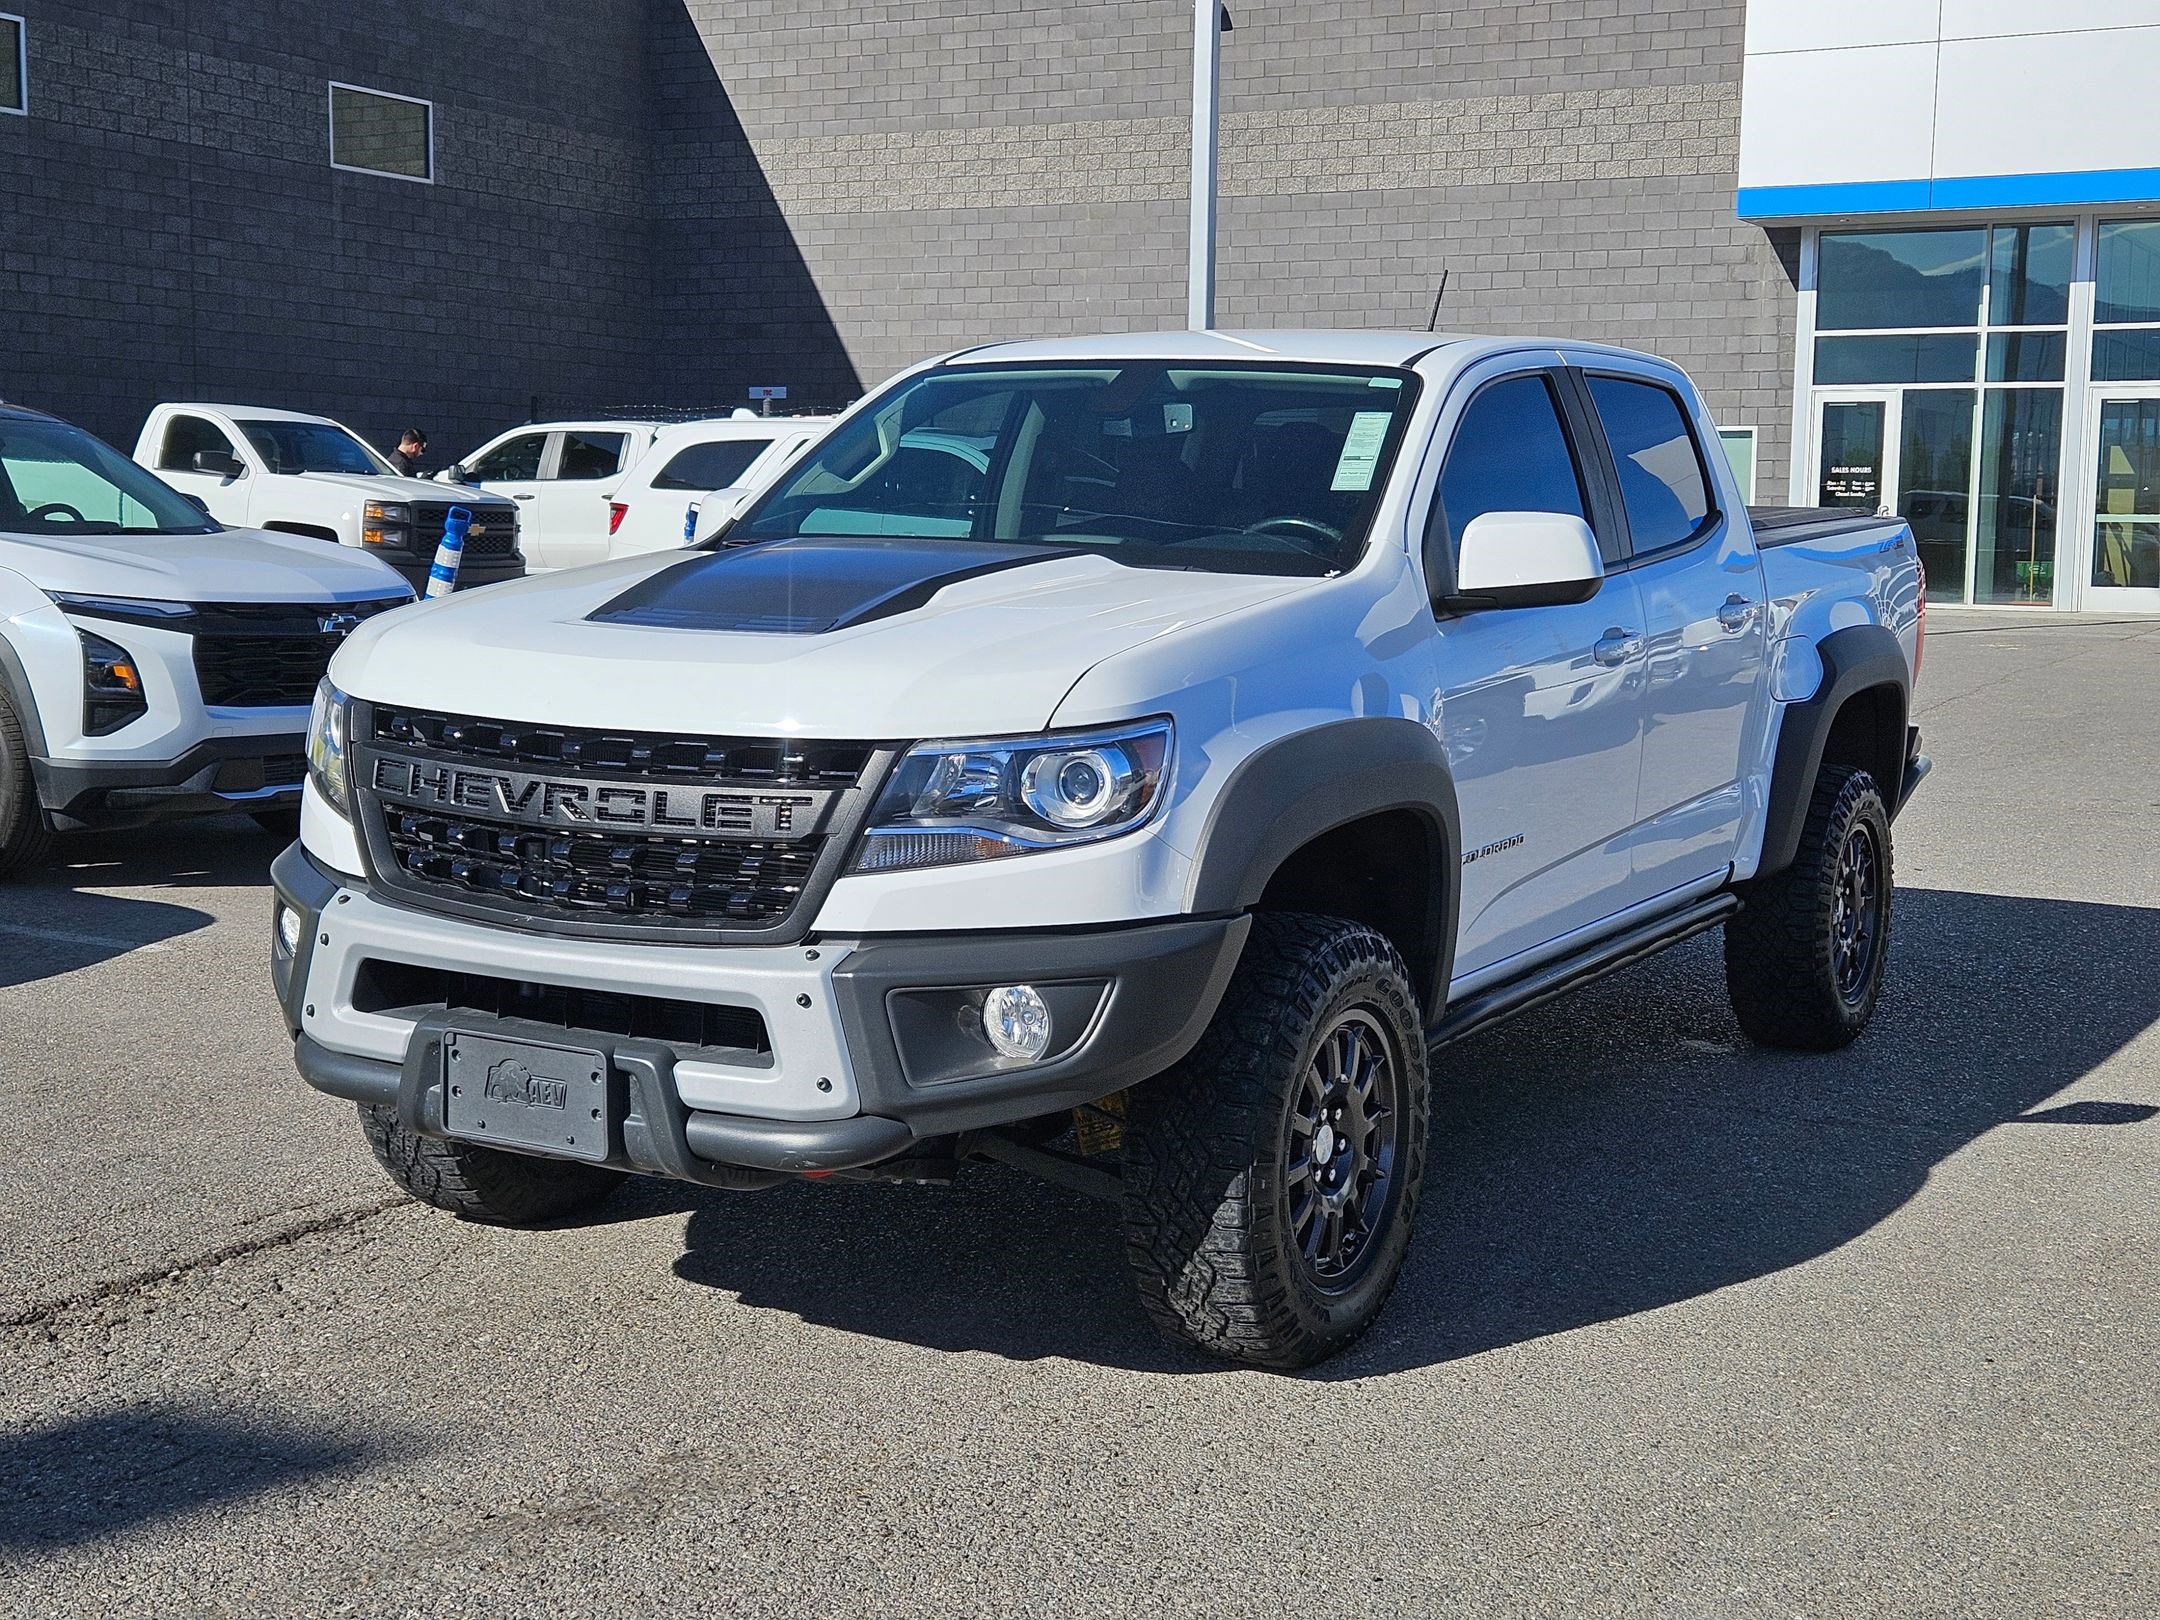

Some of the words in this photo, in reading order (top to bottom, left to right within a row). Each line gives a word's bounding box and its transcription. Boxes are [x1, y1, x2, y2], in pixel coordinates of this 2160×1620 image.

[372, 757, 814, 832] CHEVROLET
[1460, 832, 1525, 866] COLORADO
[529, 1080, 565, 1106] AEV
